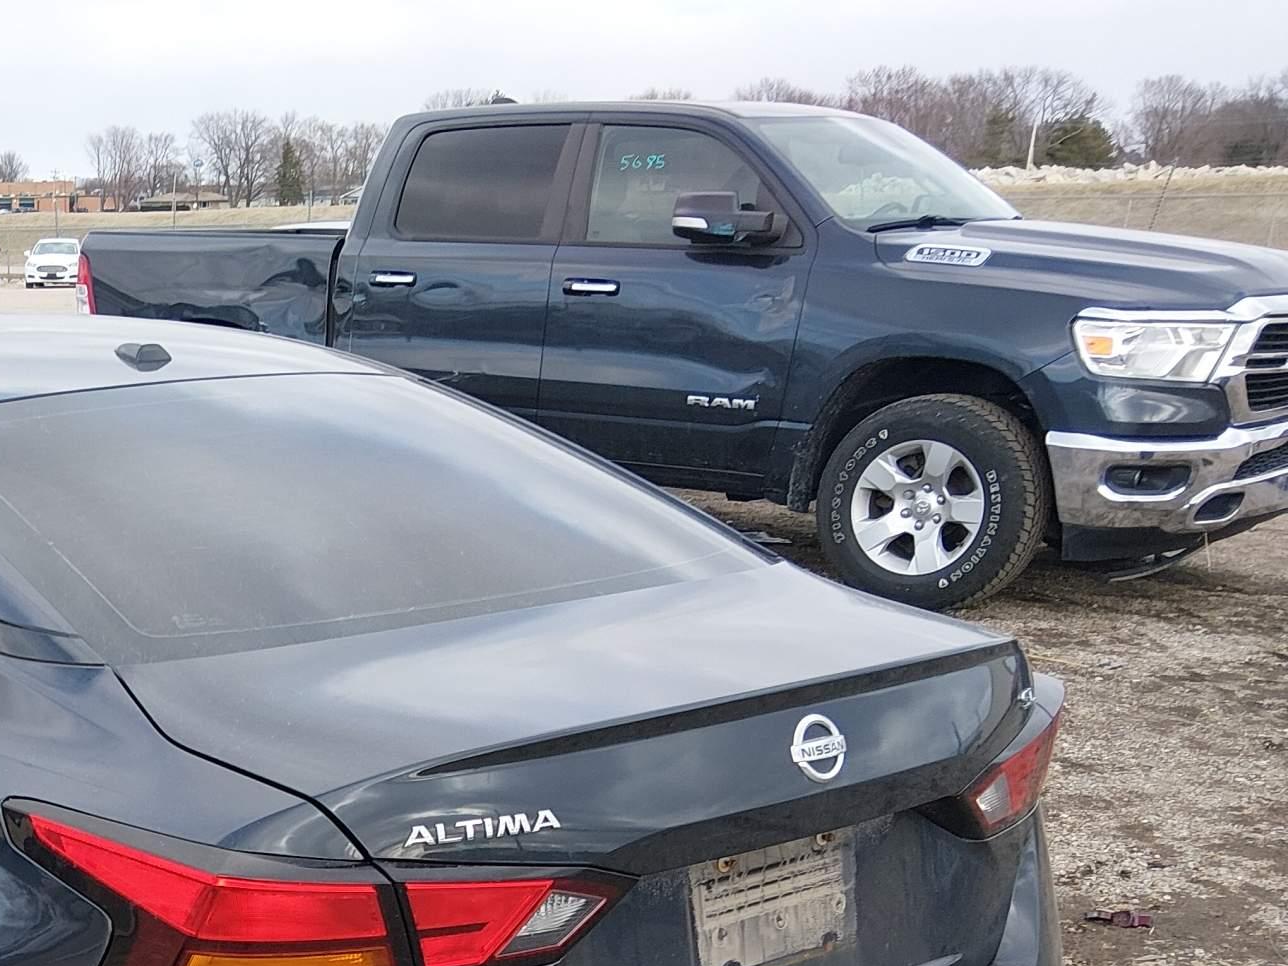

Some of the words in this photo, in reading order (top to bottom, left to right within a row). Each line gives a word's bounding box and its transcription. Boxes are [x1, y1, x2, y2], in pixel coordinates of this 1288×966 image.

[686, 395, 756, 410] RAM
[951, 470, 1001, 581] DESTINATION
[800, 741, 844, 758] NISSAN
[404, 809, 562, 847] ALTIMA
